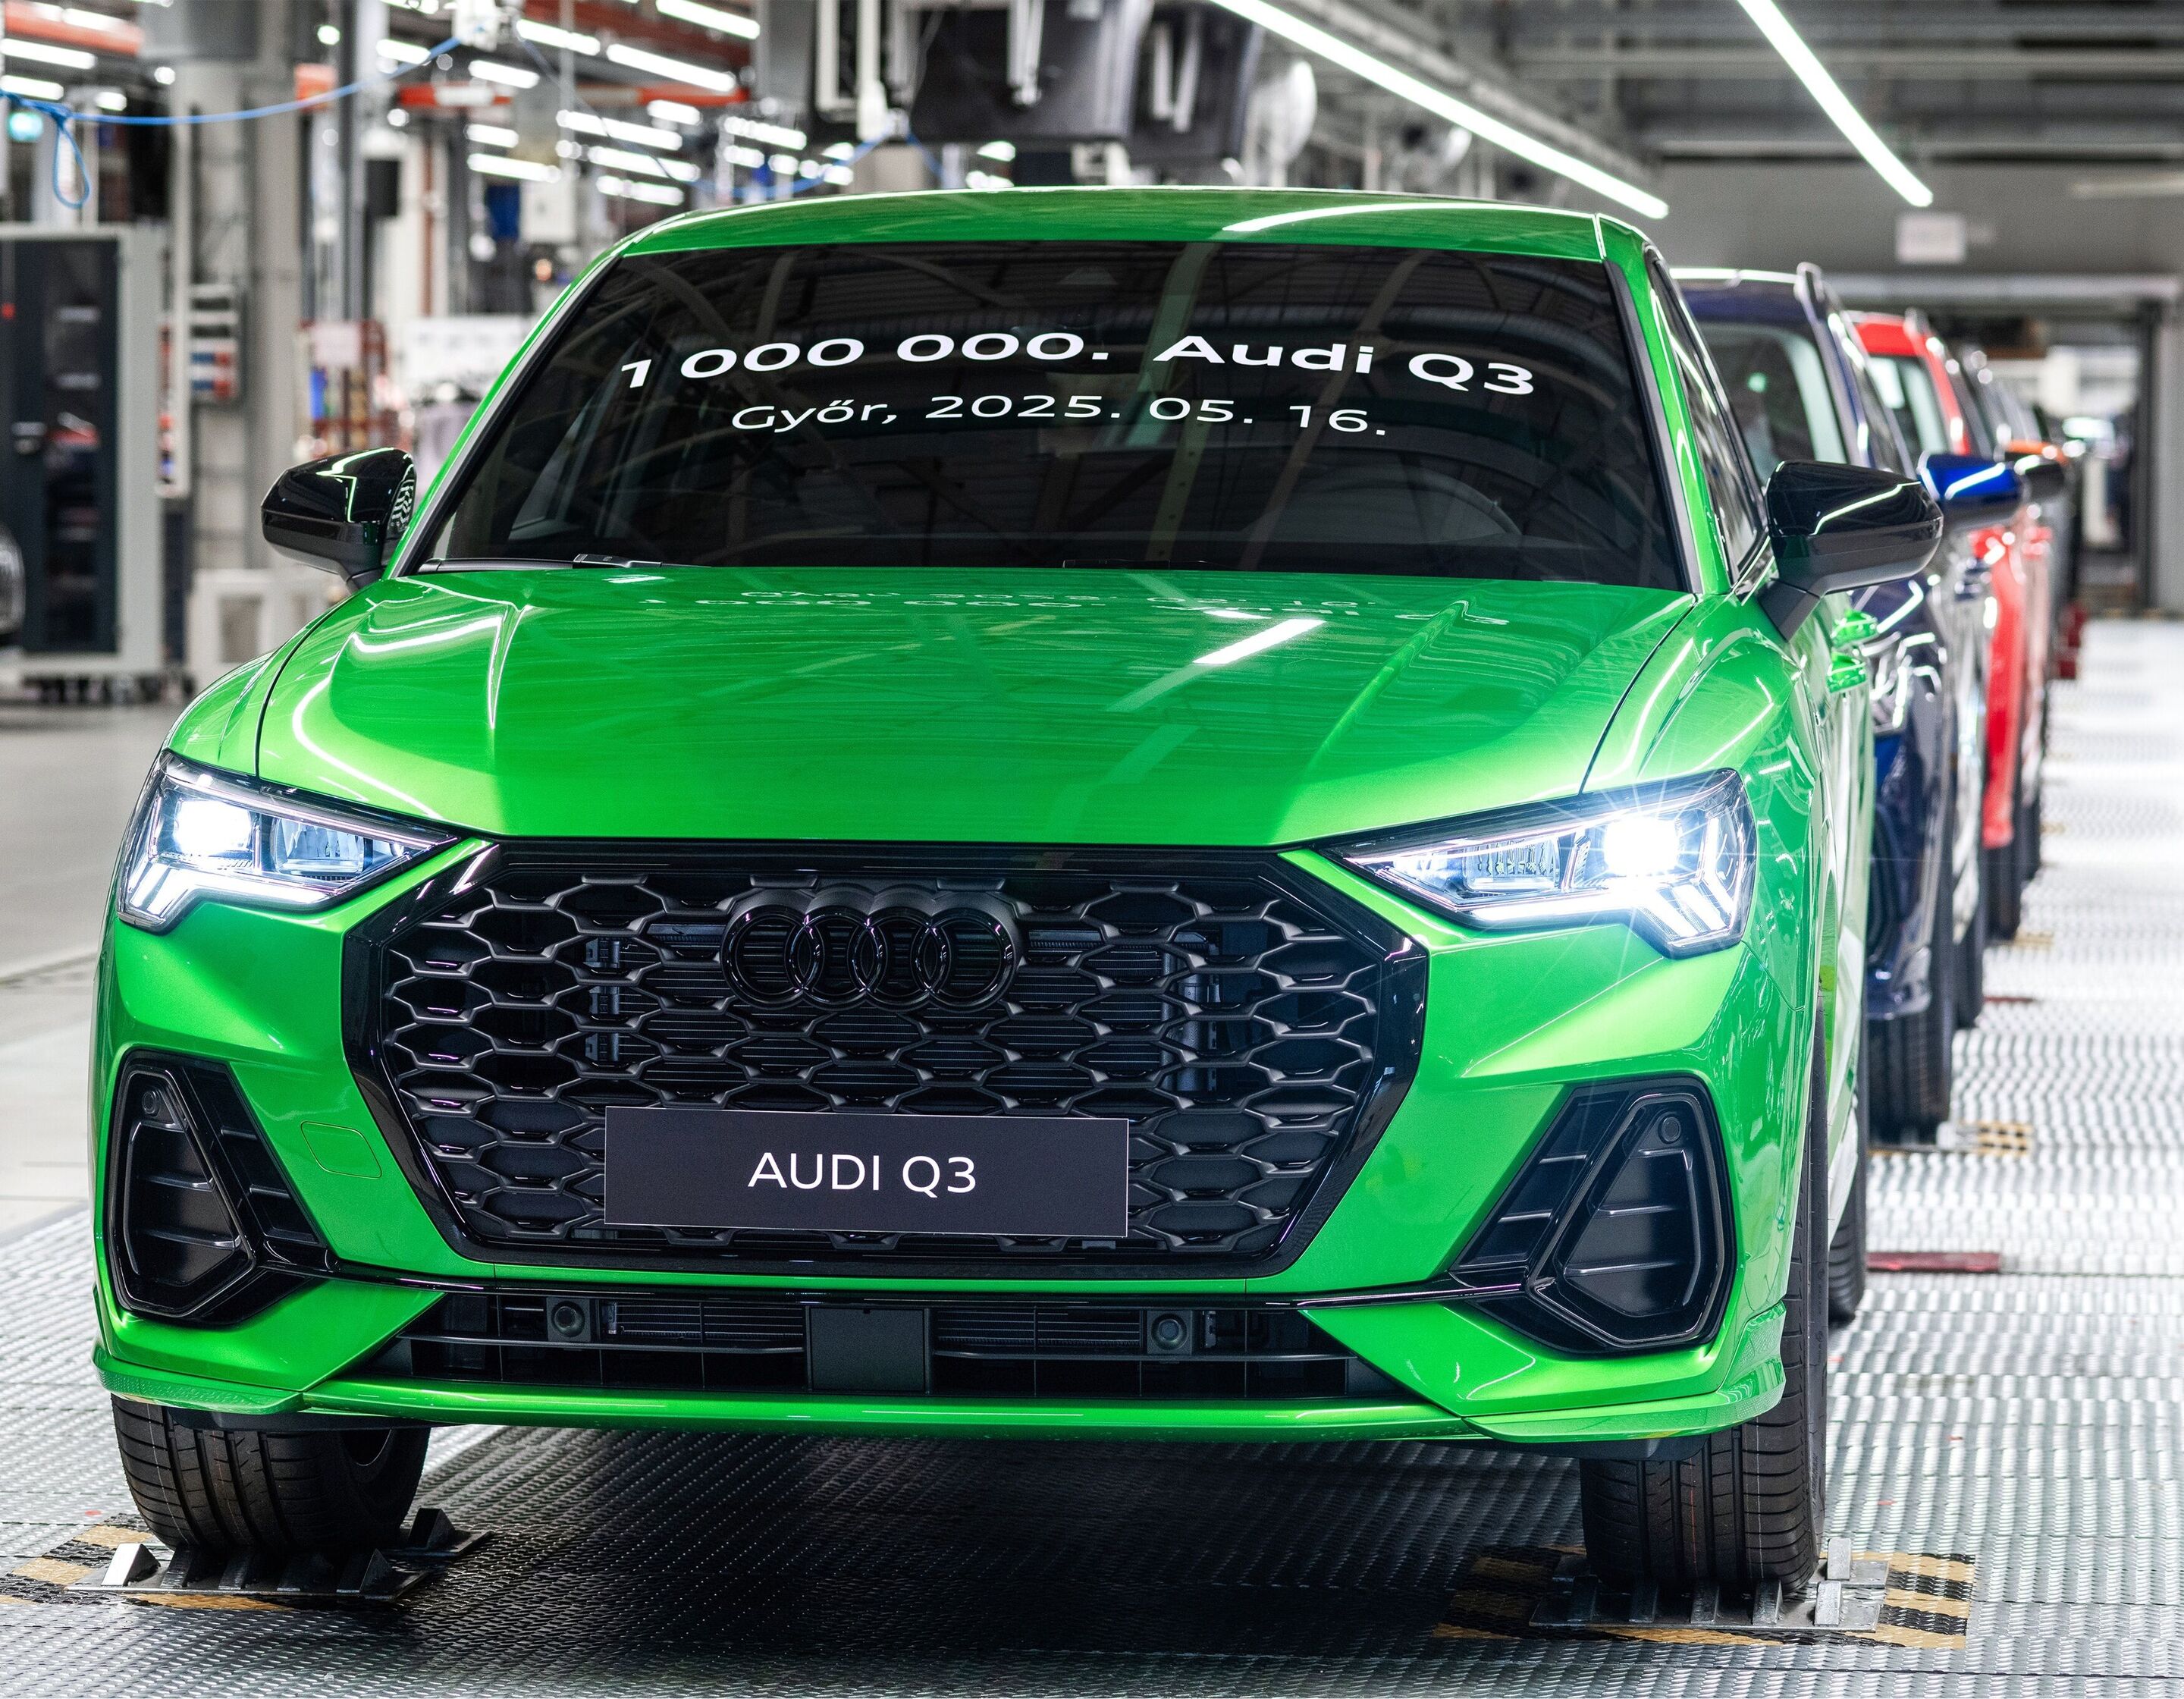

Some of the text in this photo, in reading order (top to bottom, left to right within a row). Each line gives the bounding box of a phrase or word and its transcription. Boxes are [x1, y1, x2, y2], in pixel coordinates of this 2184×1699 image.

[621, 332, 1534, 395] 1 000 000. Audi Q3
[732, 394, 1385, 436] Győr, 2025. 05. 16.
[747, 1152, 976, 1198] AUDI Q3
